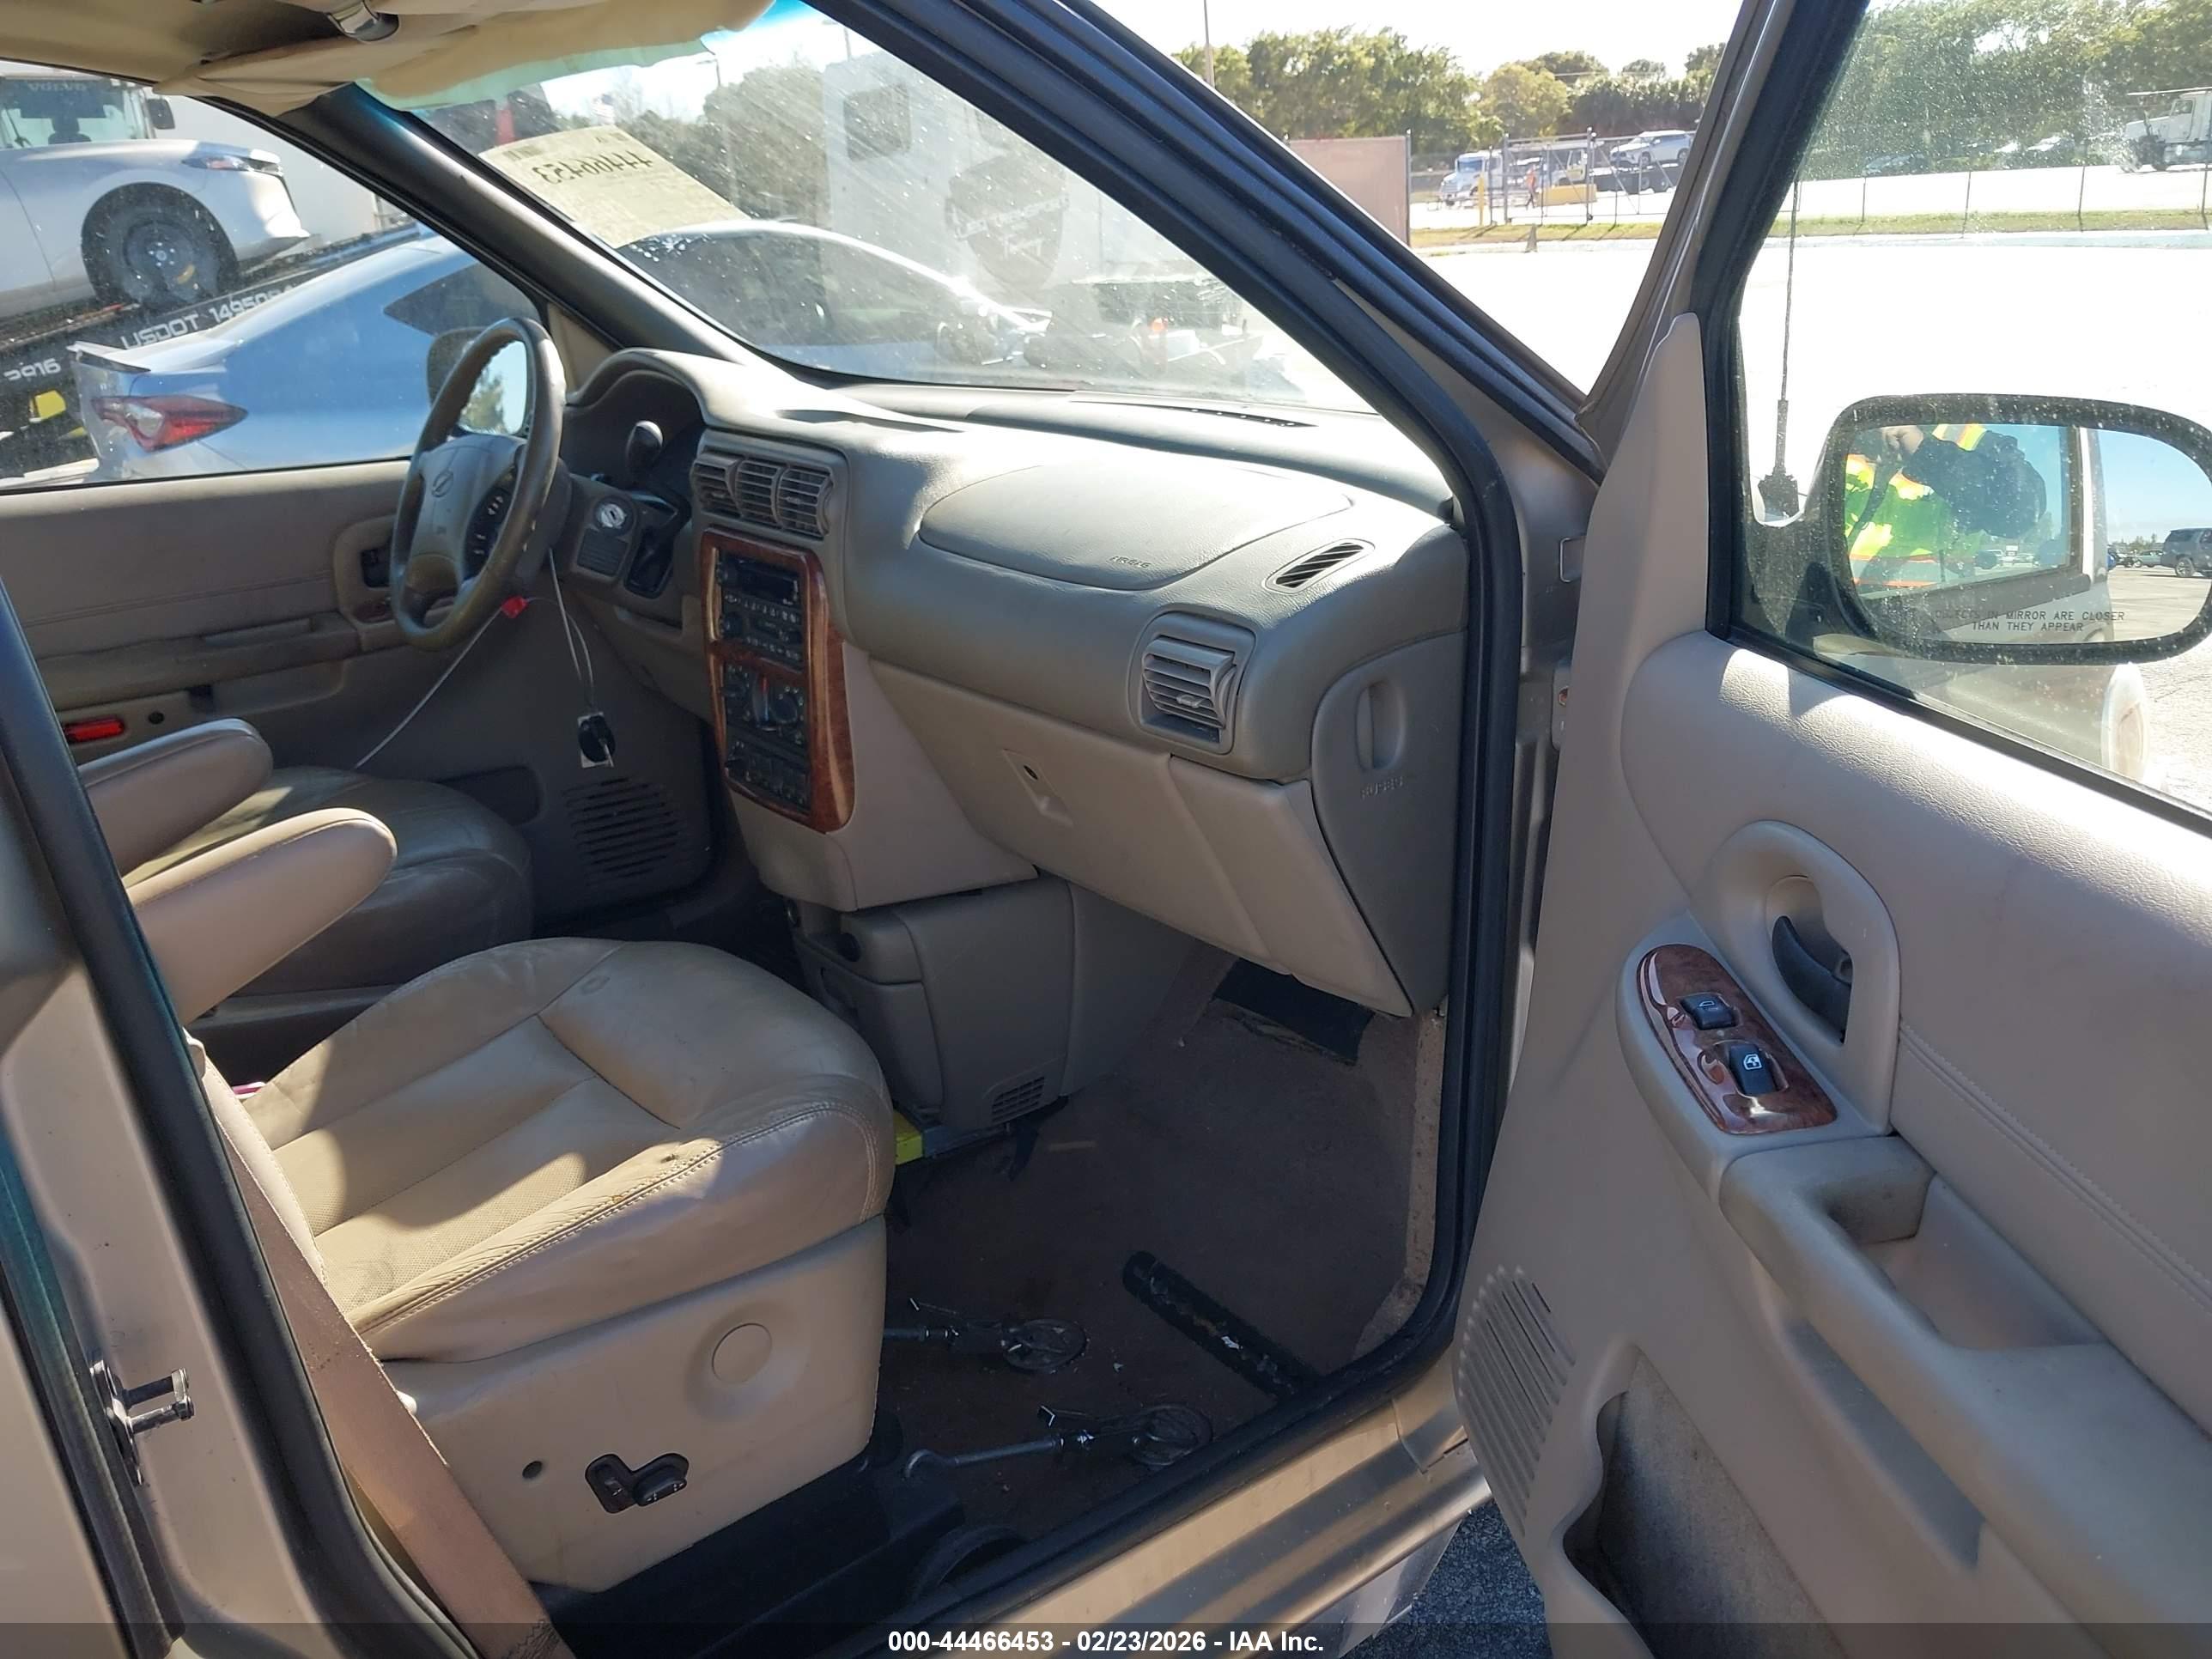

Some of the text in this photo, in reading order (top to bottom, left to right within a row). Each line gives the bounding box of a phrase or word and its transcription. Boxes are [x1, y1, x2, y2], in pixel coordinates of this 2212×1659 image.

[120, 285, 295, 349] USDOT 14950
[2005, 611, 2046, 620] MIRROR
[2053, 611, 2075, 621] ARE
[2081, 611, 2125, 621] CLOSER
[1972, 622, 2083, 632] THAN THEY APPEAR
